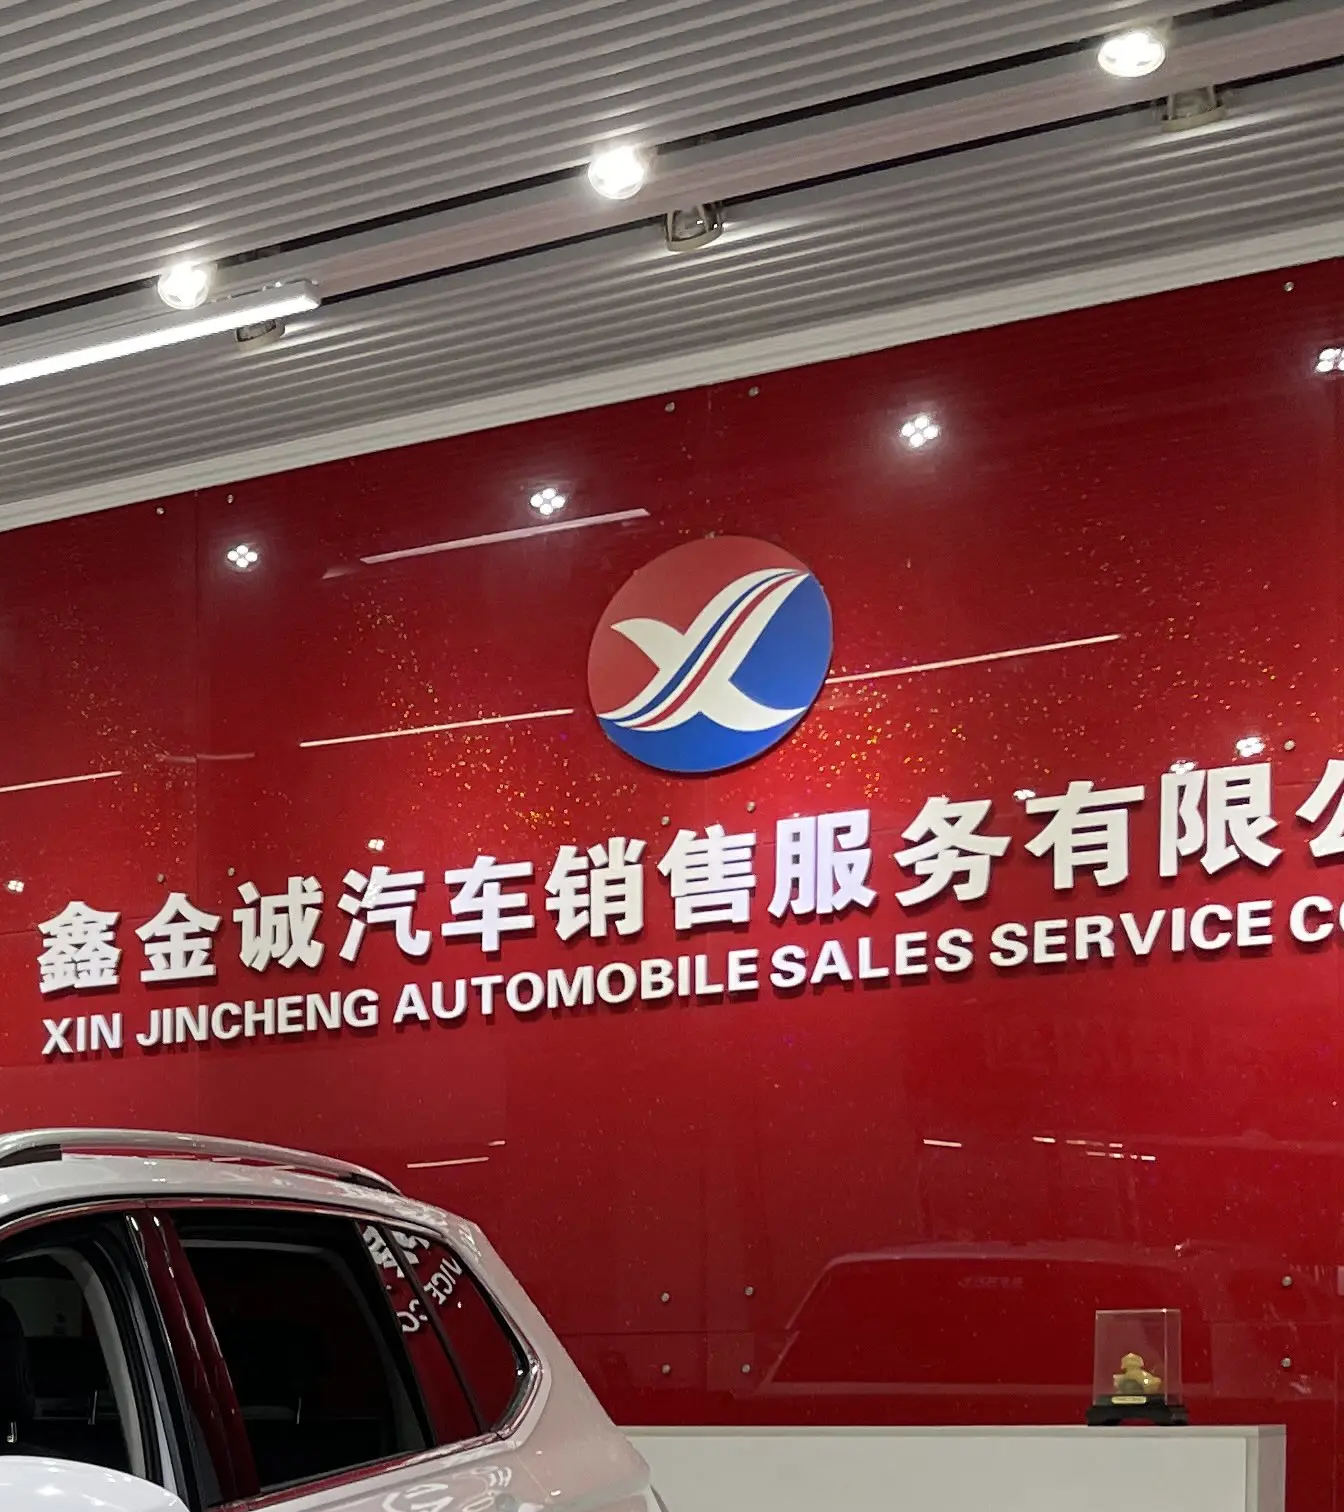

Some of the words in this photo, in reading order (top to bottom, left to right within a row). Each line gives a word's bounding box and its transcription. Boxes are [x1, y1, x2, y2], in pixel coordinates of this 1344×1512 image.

[41, 1012, 123, 1055] XIN
[136, 988, 379, 1048] JINCHENG
[393, 948, 759, 1028] AUTOMOBILE
[769, 928, 974, 990] SALES
[989, 899, 1274, 969] SERVICE
